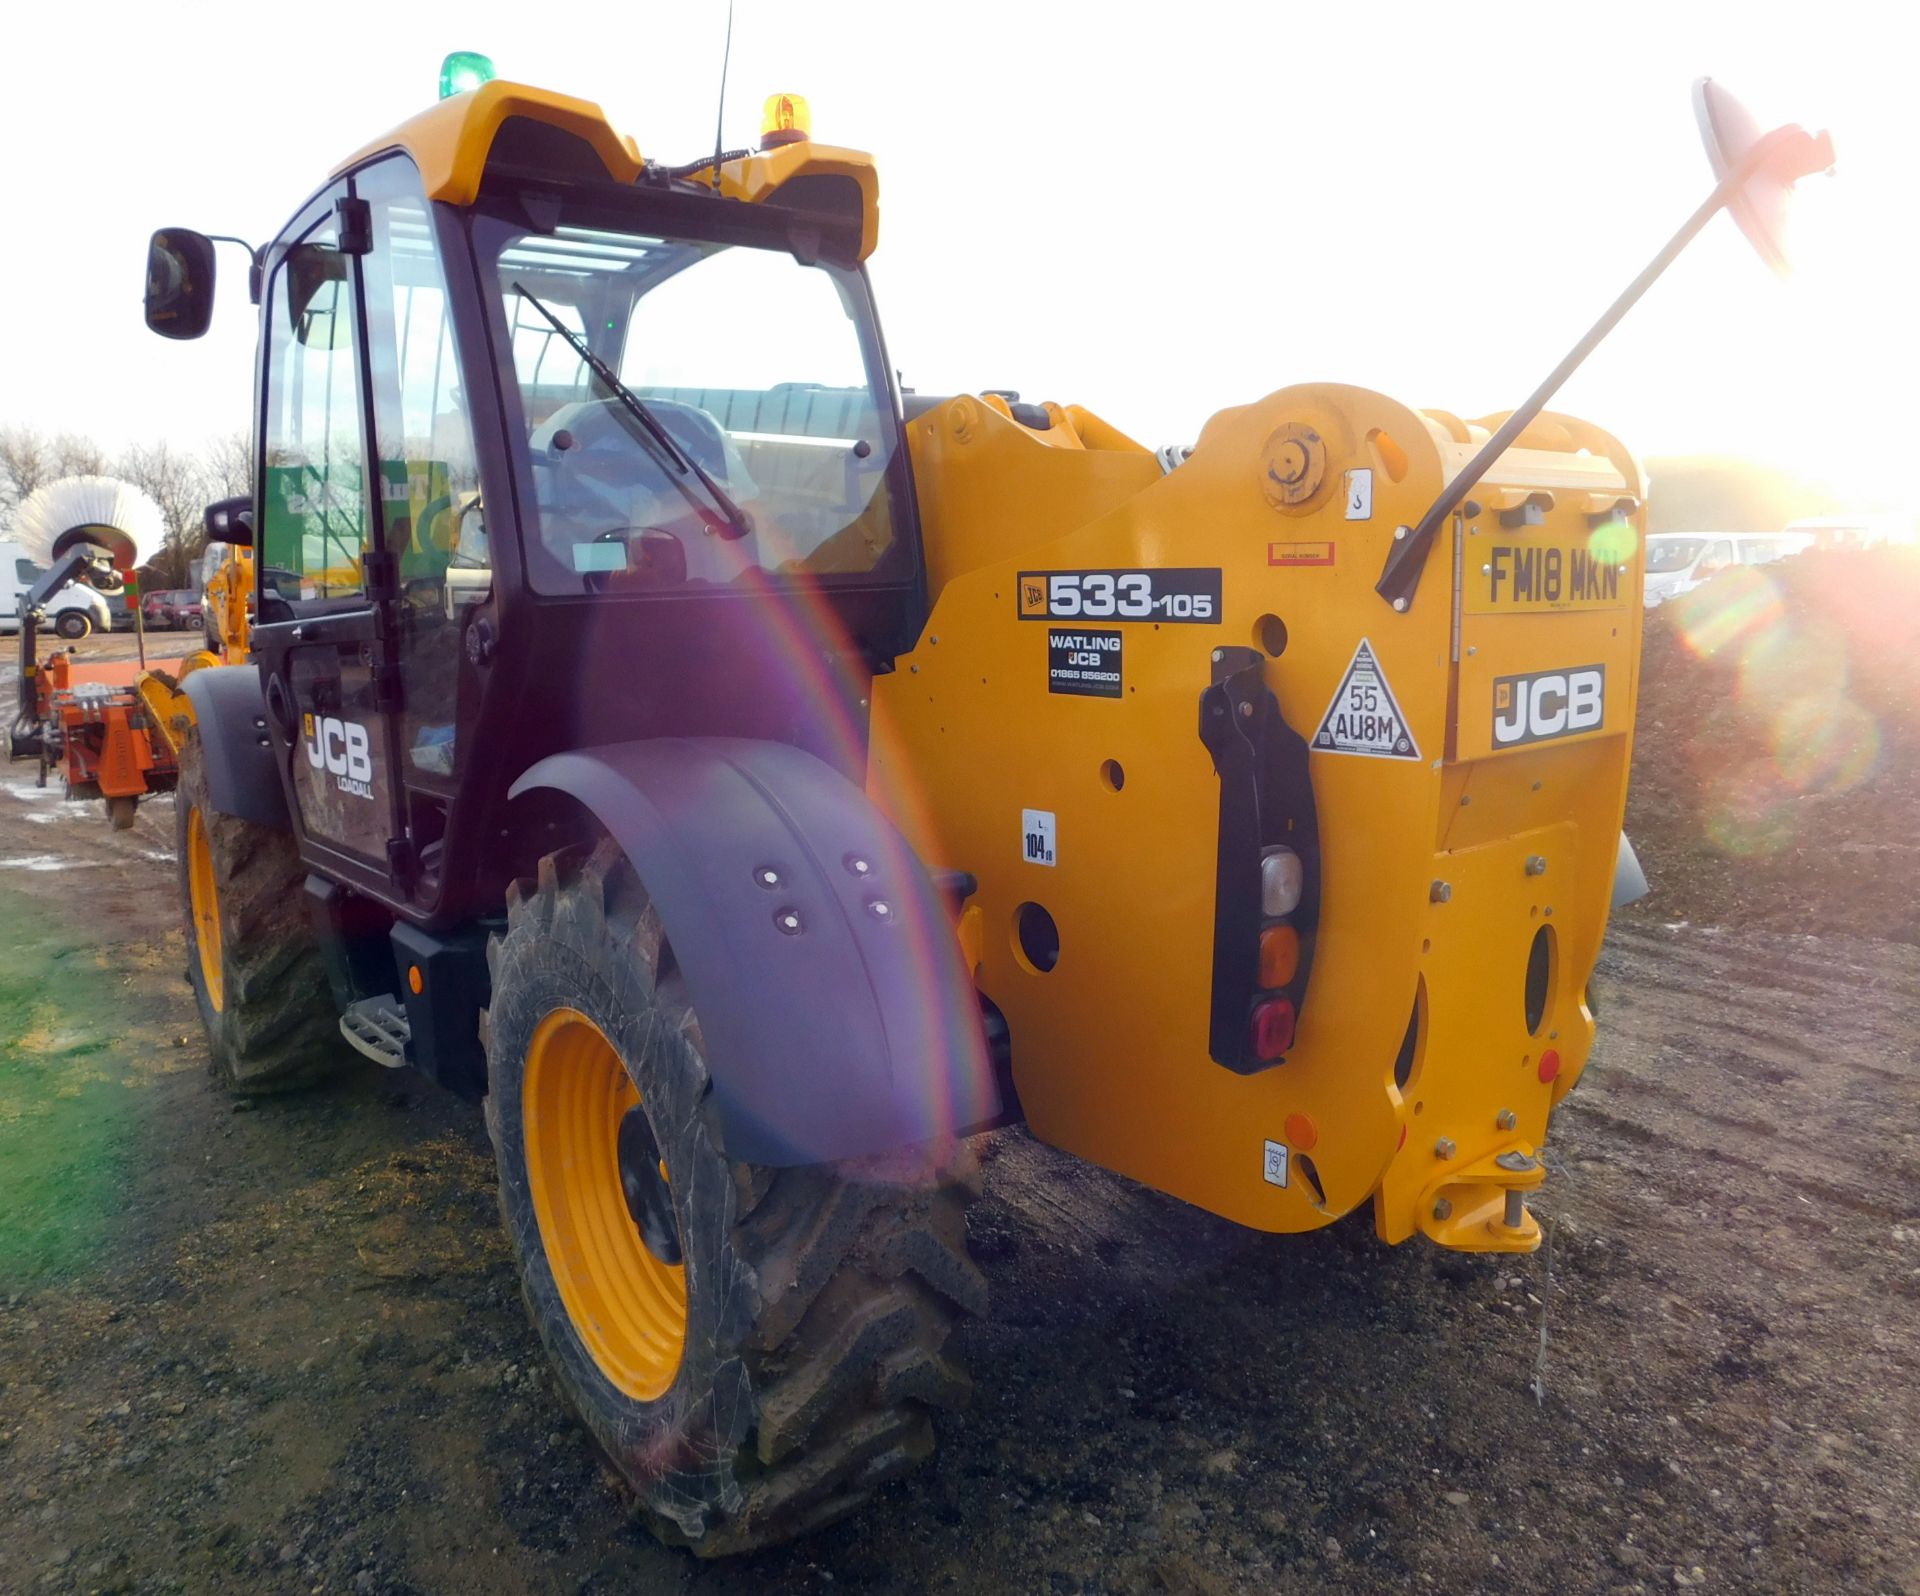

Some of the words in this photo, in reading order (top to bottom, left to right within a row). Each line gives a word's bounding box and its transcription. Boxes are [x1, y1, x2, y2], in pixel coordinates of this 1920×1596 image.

[1490, 547, 1562, 603] FM18
[1569, 548, 1618, 601] MKN
[1050, 635, 1120, 651] WATLING
[1068, 652, 1101, 666] JCB
[1050, 669, 1080, 679] 01865
[1081, 671, 1120, 682] 856200
[1350, 685, 1377, 712] 55
[1494, 670, 1602, 742] JCB
[1335, 713, 1393, 743] AU8M
[307, 714, 372, 783] JCB
[337, 776, 375, 800] LOADALL
[1025, 832, 1044, 859] 104
